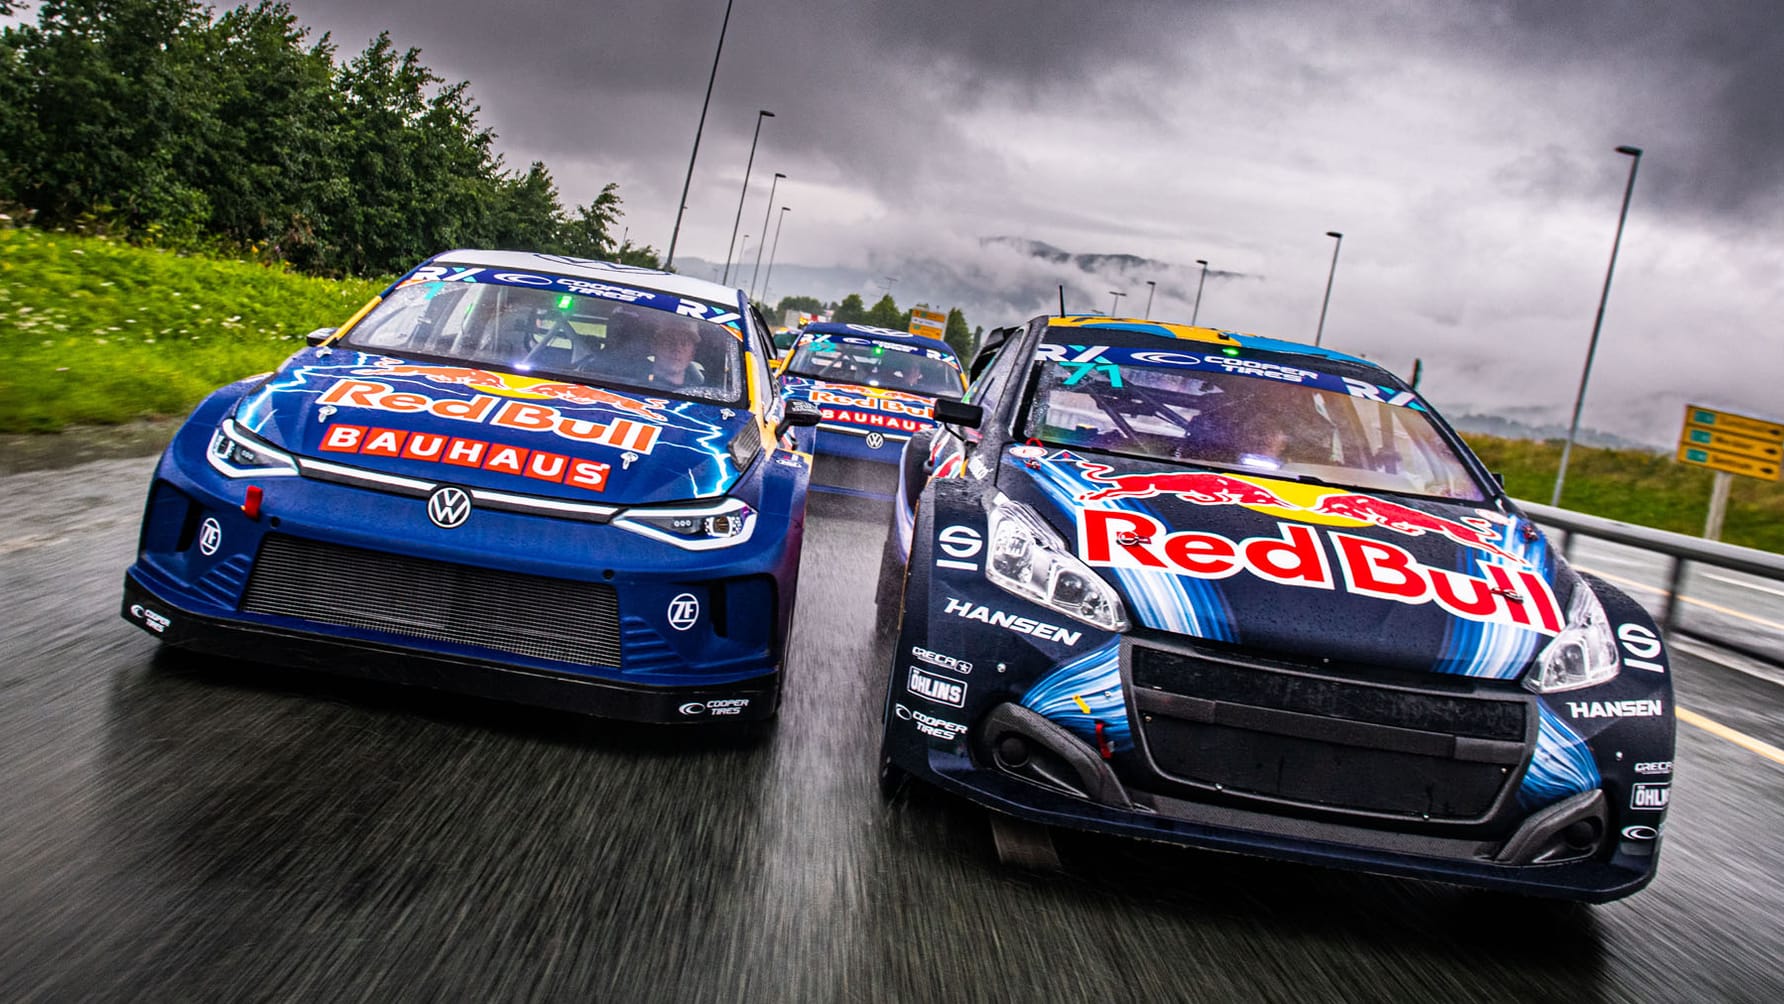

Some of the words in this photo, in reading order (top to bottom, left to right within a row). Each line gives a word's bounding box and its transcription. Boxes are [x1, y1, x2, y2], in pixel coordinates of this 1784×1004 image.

[409, 267, 486, 282] RX
[557, 278, 656, 300] COOPER
[568, 286, 640, 302] TIRES
[676, 299, 742, 329] RX
[1035, 343, 1113, 364] RX
[1058, 361, 1124, 388] 71
[1204, 356, 1318, 379] COOPER
[1221, 364, 1304, 383] TIRES
[809, 390, 878, 409] Red
[880, 399, 935, 420] Bul
[1341, 377, 1427, 412] RX
[316, 379, 501, 423] Red
[490, 398, 662, 454] Bull
[326, 427, 607, 486] BAUHAUS
[1078, 506, 1335, 590] Red
[1327, 530, 1567, 637] Bull
[669, 598, 698, 625] ZF
[944, 597, 1082, 646] HANSEN
[911, 669, 962, 703] ÖHLINS
[706, 699, 749, 709] COOPER
[711, 706, 742, 716] TIRES
[1566, 700, 1662, 718] HANSEN
[912, 710, 968, 734] COOPER
[916, 721, 957, 740] TIRES
